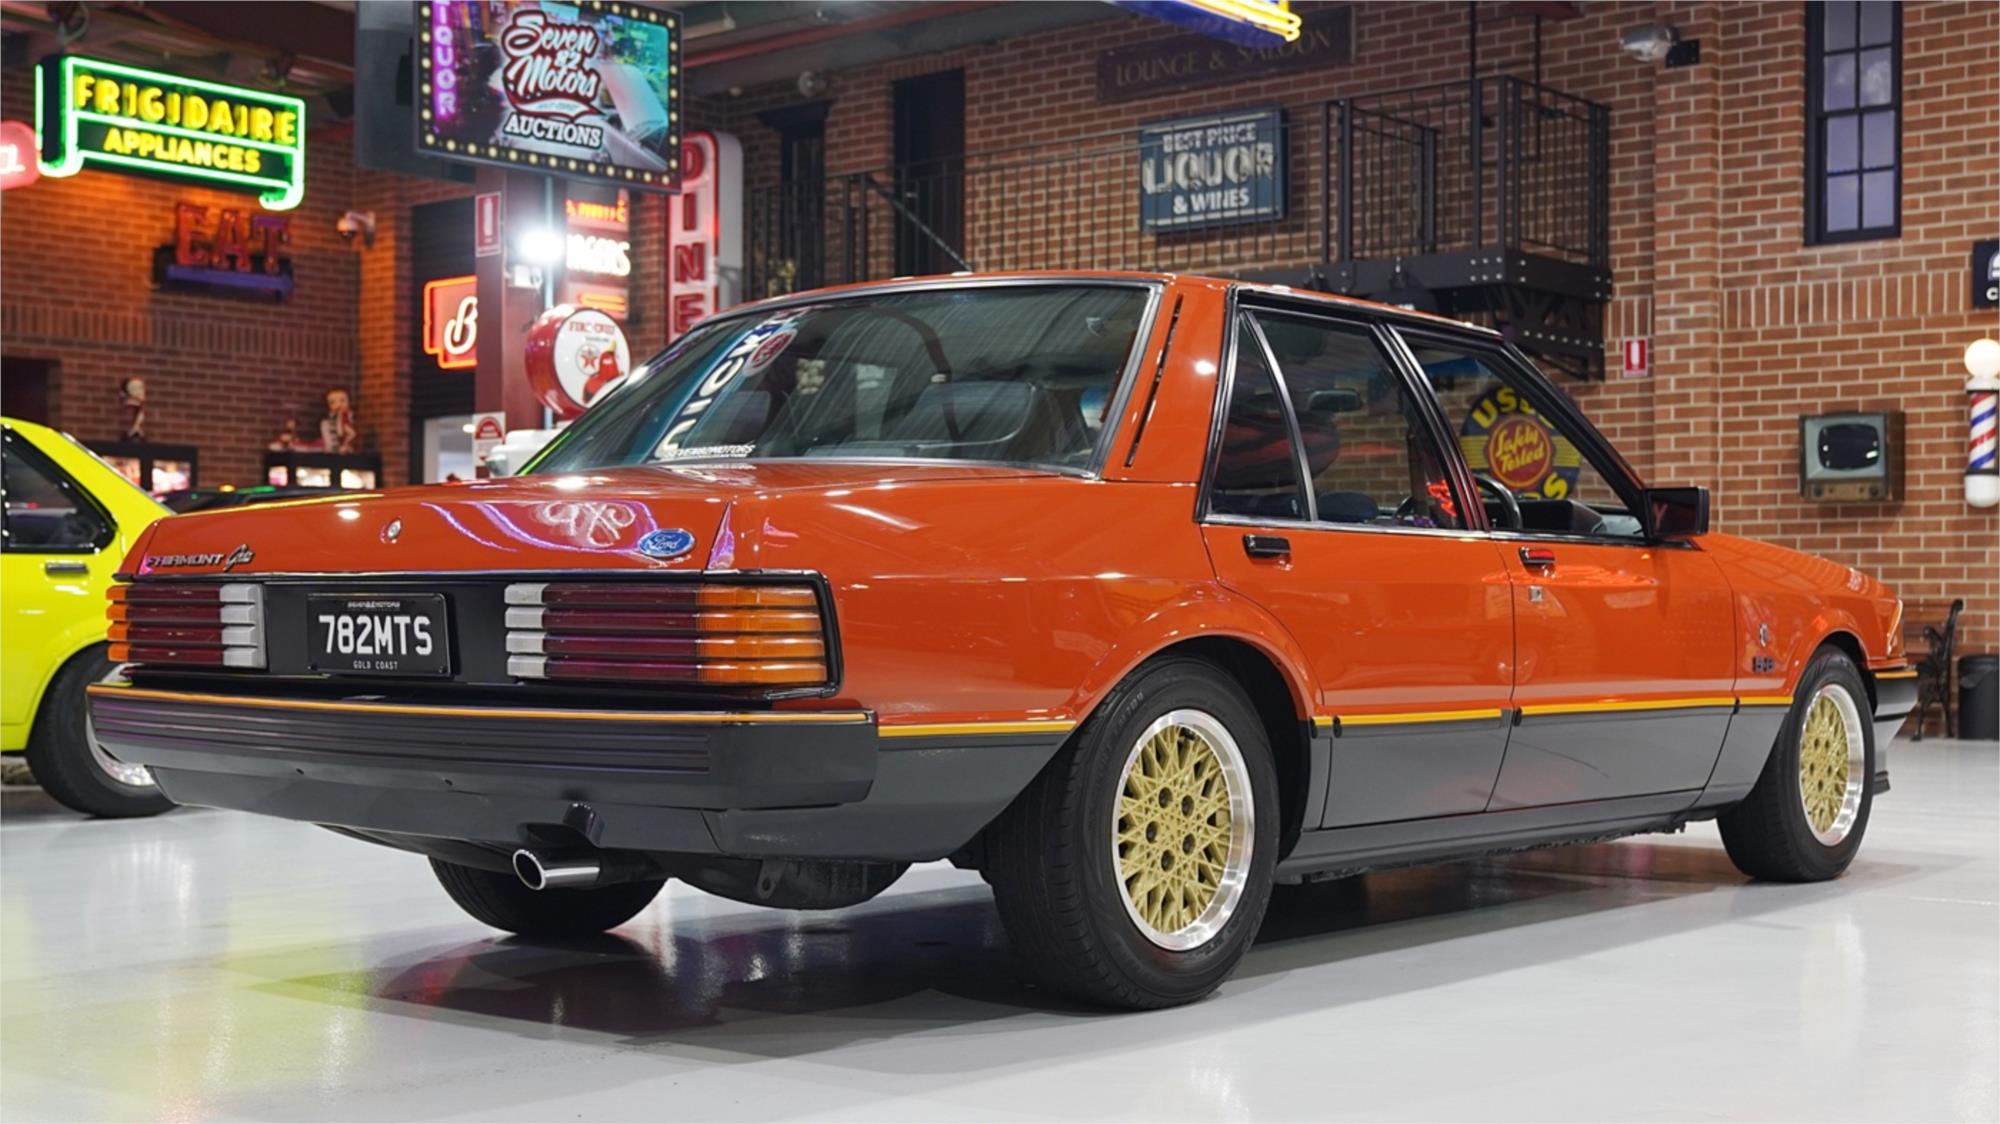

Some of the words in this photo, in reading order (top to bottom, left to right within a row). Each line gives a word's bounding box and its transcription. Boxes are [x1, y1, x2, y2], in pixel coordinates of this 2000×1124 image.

[505, 13, 596, 57] Seven
[434, 0, 456, 116] IQUOR
[506, 54, 599, 98] Motors
[1115, 52, 1199, 87] LOUNGE
[1208, 49, 1225, 71] &
[74, 74, 297, 145] FRIGIDAIRE
[504, 113, 602, 147] AUCTIONS
[103, 126, 262, 174] APPLIANCES
[1162, 129, 1203, 153] BEST
[1205, 122, 1257, 147] PRICE
[1142, 142, 1274, 195] LIQUOR
[1172, 194, 1189, 215] &
[1190, 187, 1250, 213] WINES
[176, 203, 289, 274] EAT
[147, 553, 224, 568] FAIRMONT
[319, 615, 433, 656] 782MTS
[353, 660, 371, 670] GOLD
[375, 661, 398, 670] COAST
